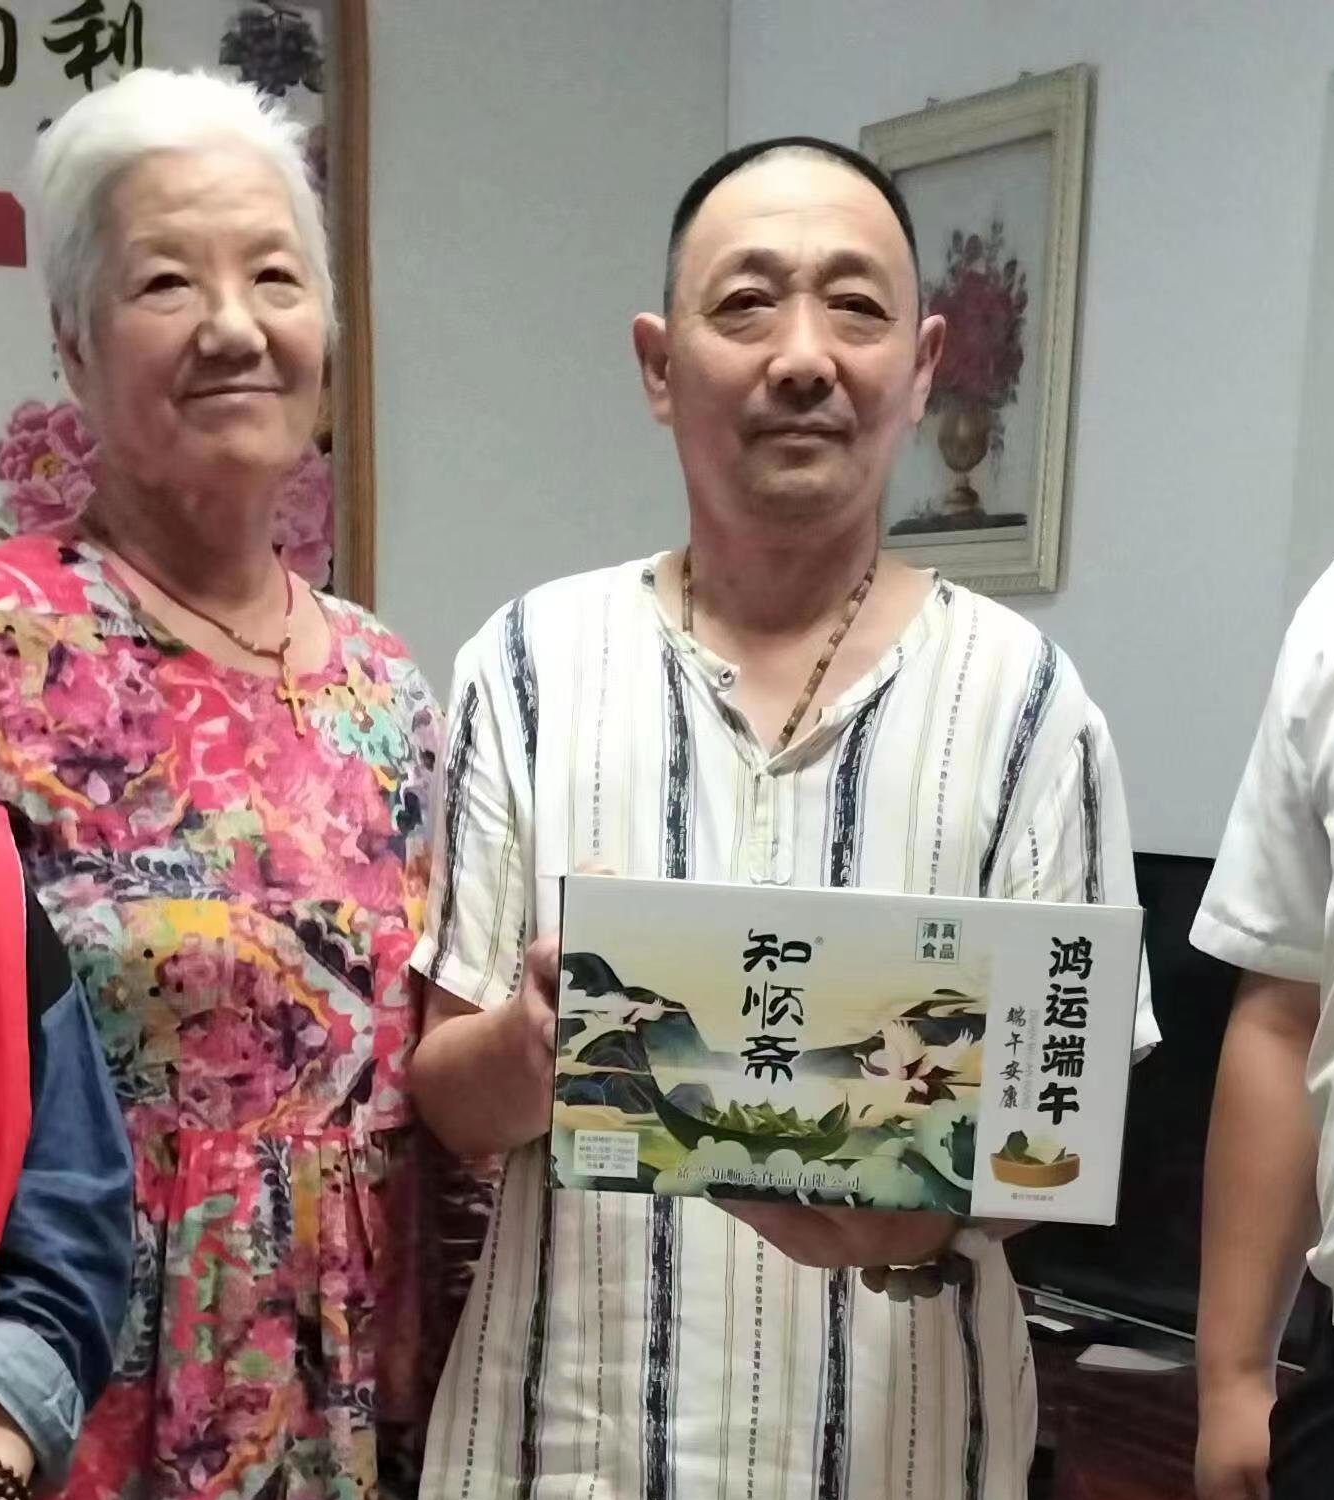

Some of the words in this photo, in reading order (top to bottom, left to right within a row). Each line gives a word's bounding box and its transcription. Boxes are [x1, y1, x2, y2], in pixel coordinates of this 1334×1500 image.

[740, 928, 812, 1084] 知顺斋
[999, 1005, 1027, 1109] 端午安康
[1037, 936, 1093, 1125] 鸿运端午
